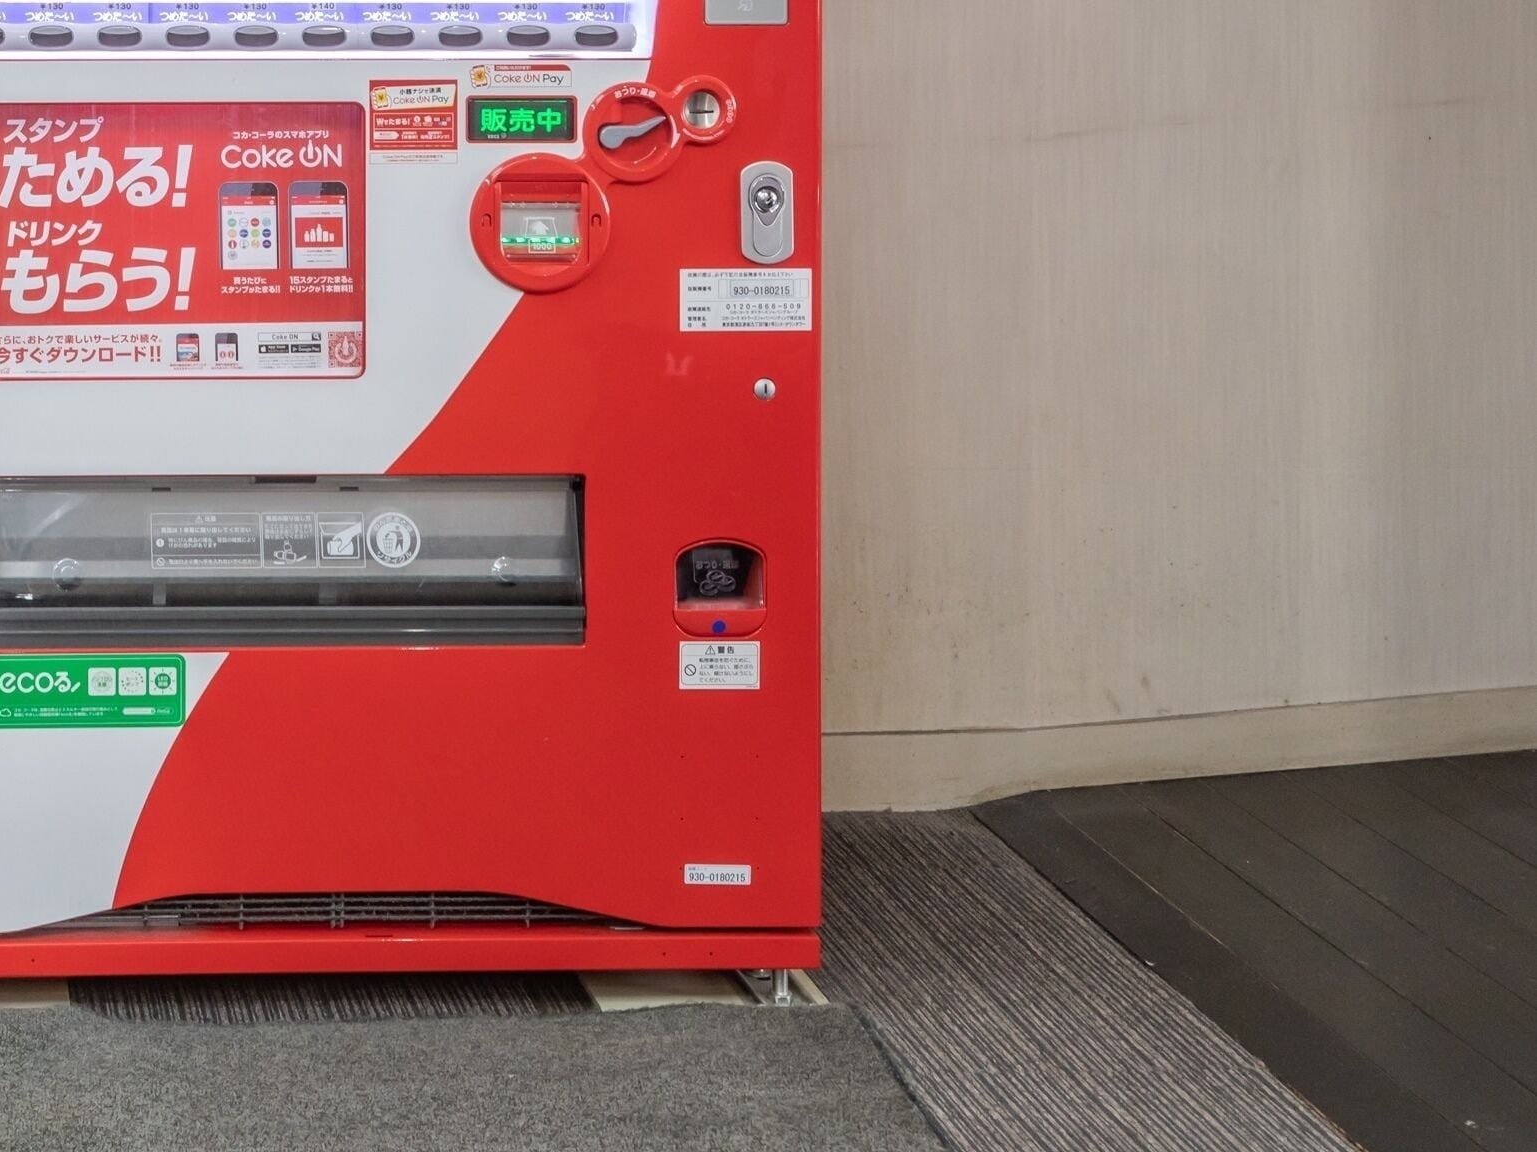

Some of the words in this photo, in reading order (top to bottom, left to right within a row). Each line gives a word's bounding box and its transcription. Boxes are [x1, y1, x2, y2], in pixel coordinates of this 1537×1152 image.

[494, 74, 521, 84] Coke
[524, 73, 540, 83] ON
[543, 74, 564, 85] Pay
[432, 95, 449, 104] Pay
[481, 108, 562, 132] 販売中
[3, 116, 103, 144] スタンプ
[233, 131, 329, 139] コカ・コーラのスマホアプリ
[221, 145, 293, 168] Coke
[299, 140, 342, 167] ON
[7, 221, 102, 247] ドリンク
[1, 247, 196, 314] もらう!
[733, 287, 790, 295] 930-0180215
[689, 873, 745, 882] 930-0180215
